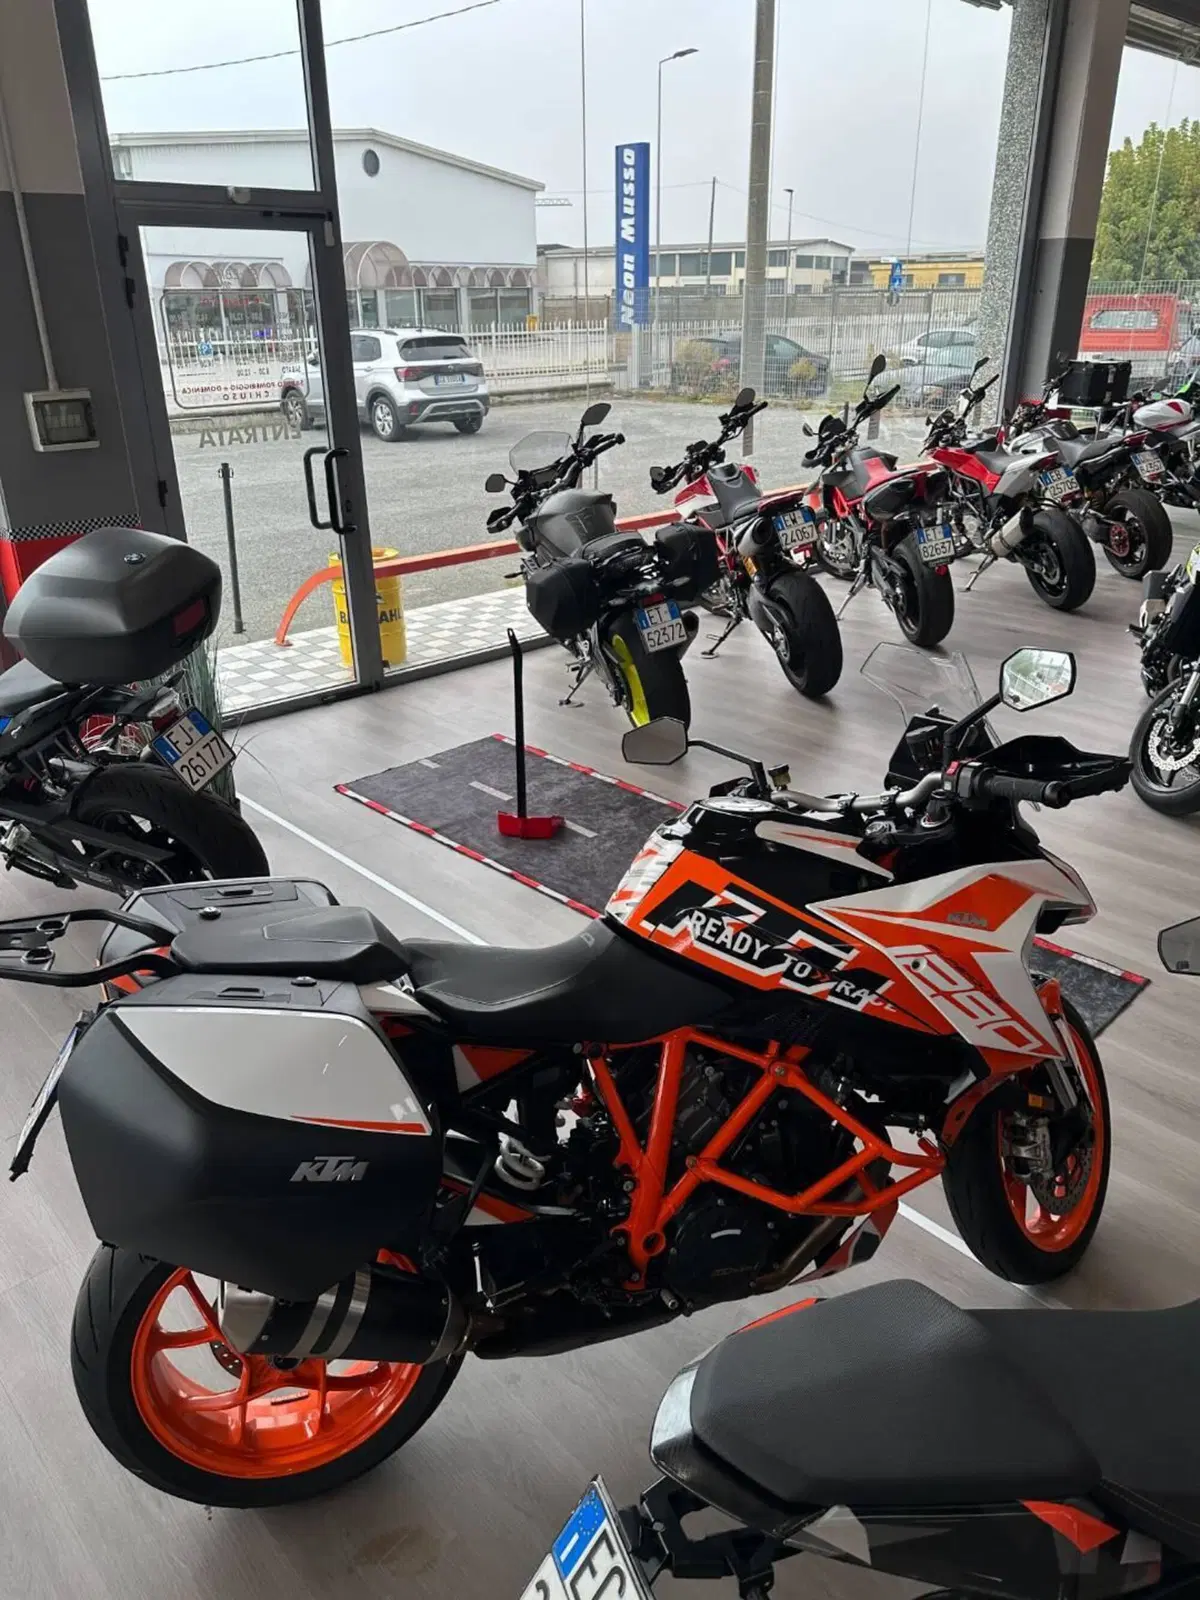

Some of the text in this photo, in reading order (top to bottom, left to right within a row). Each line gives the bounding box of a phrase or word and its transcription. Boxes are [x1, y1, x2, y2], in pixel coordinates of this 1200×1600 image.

[620, 148, 636, 326] Neon Musso
[782, 524, 815, 546] 24067
[340, 608, 402, 625] BAHL
[647, 606, 664, 625] ET
[646, 622, 686, 648] 52372
[166, 723, 194, 754] FJ
[180, 736, 226, 786] 26177
[690, 908, 773, 962] READY
[783, 952, 812, 979] TO
[289, 1155, 370, 1182] KTM
